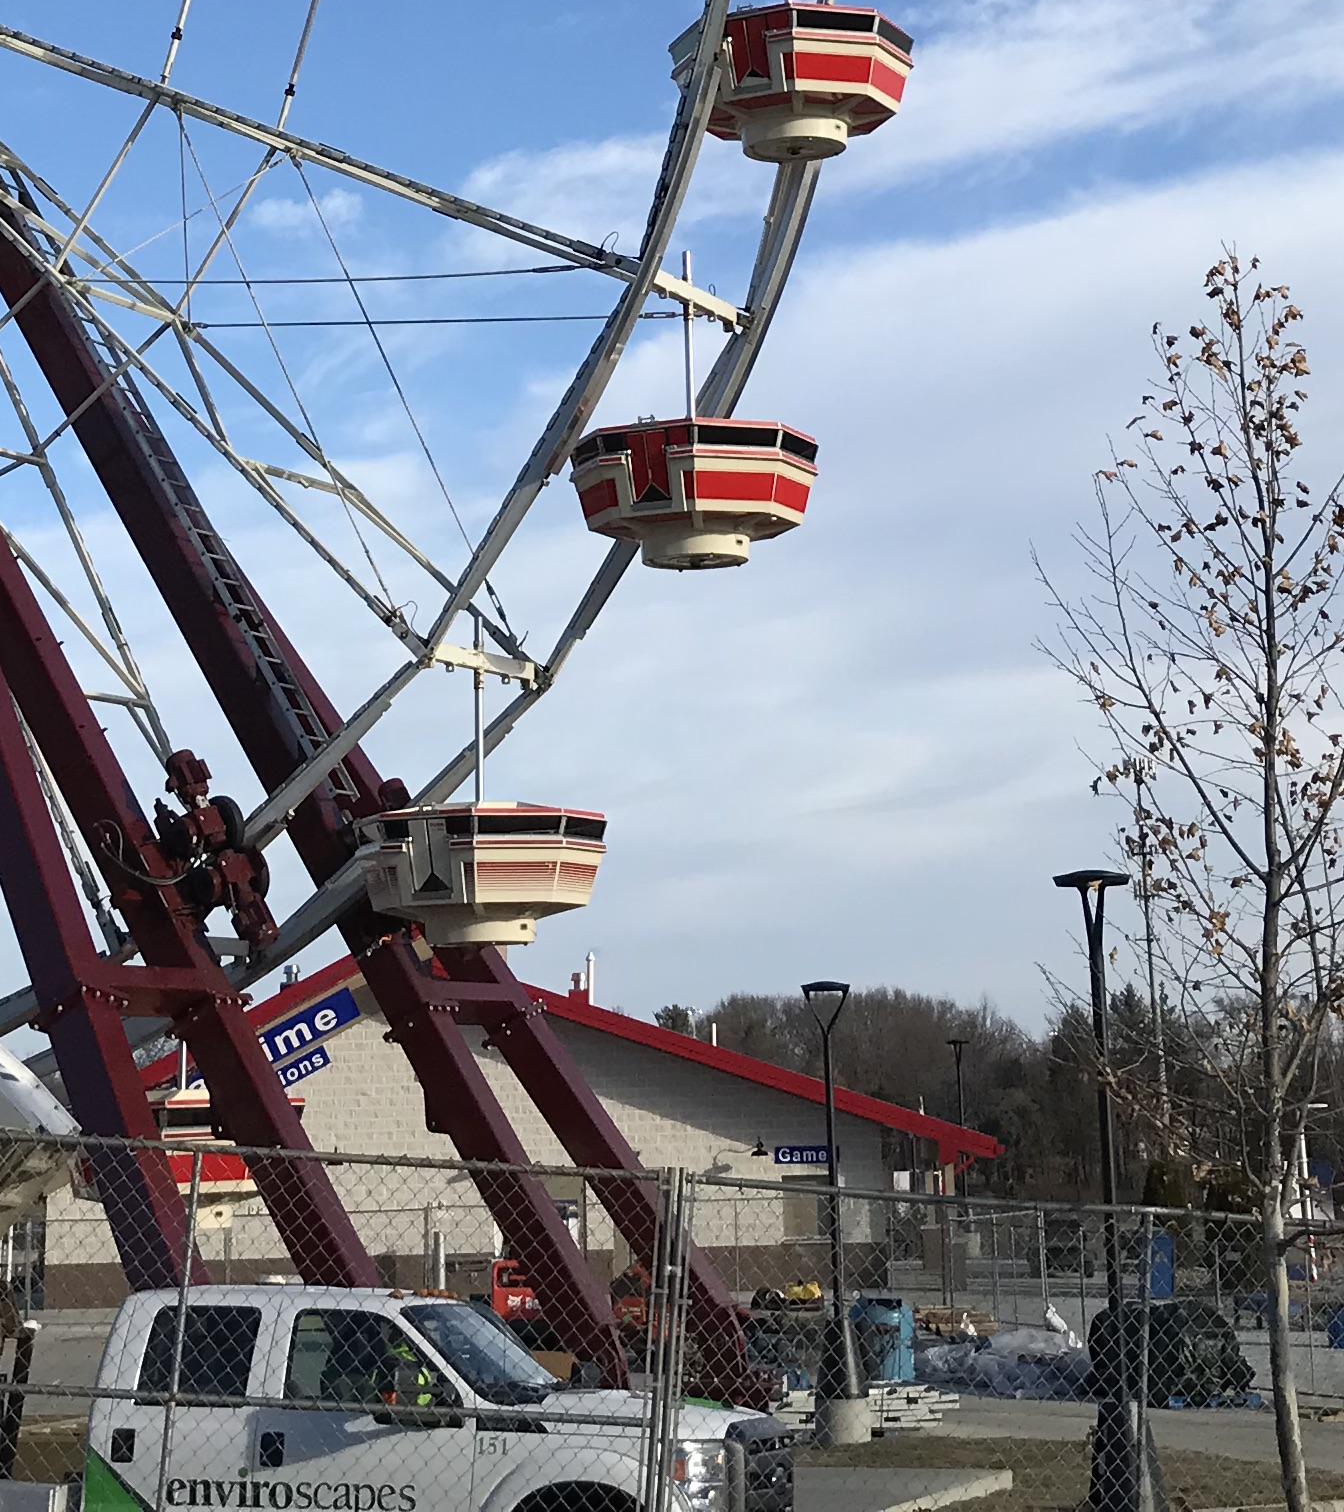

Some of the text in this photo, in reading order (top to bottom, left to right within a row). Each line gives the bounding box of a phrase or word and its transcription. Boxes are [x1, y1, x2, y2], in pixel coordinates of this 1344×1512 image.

[258, 1008, 338, 1062] ime
[277, 1052, 325, 1086] ions
[778, 1148, 828, 1162] Game
[477, 1436, 508, 1456] 151
[166, 1466, 417, 1512] enviroscapes
